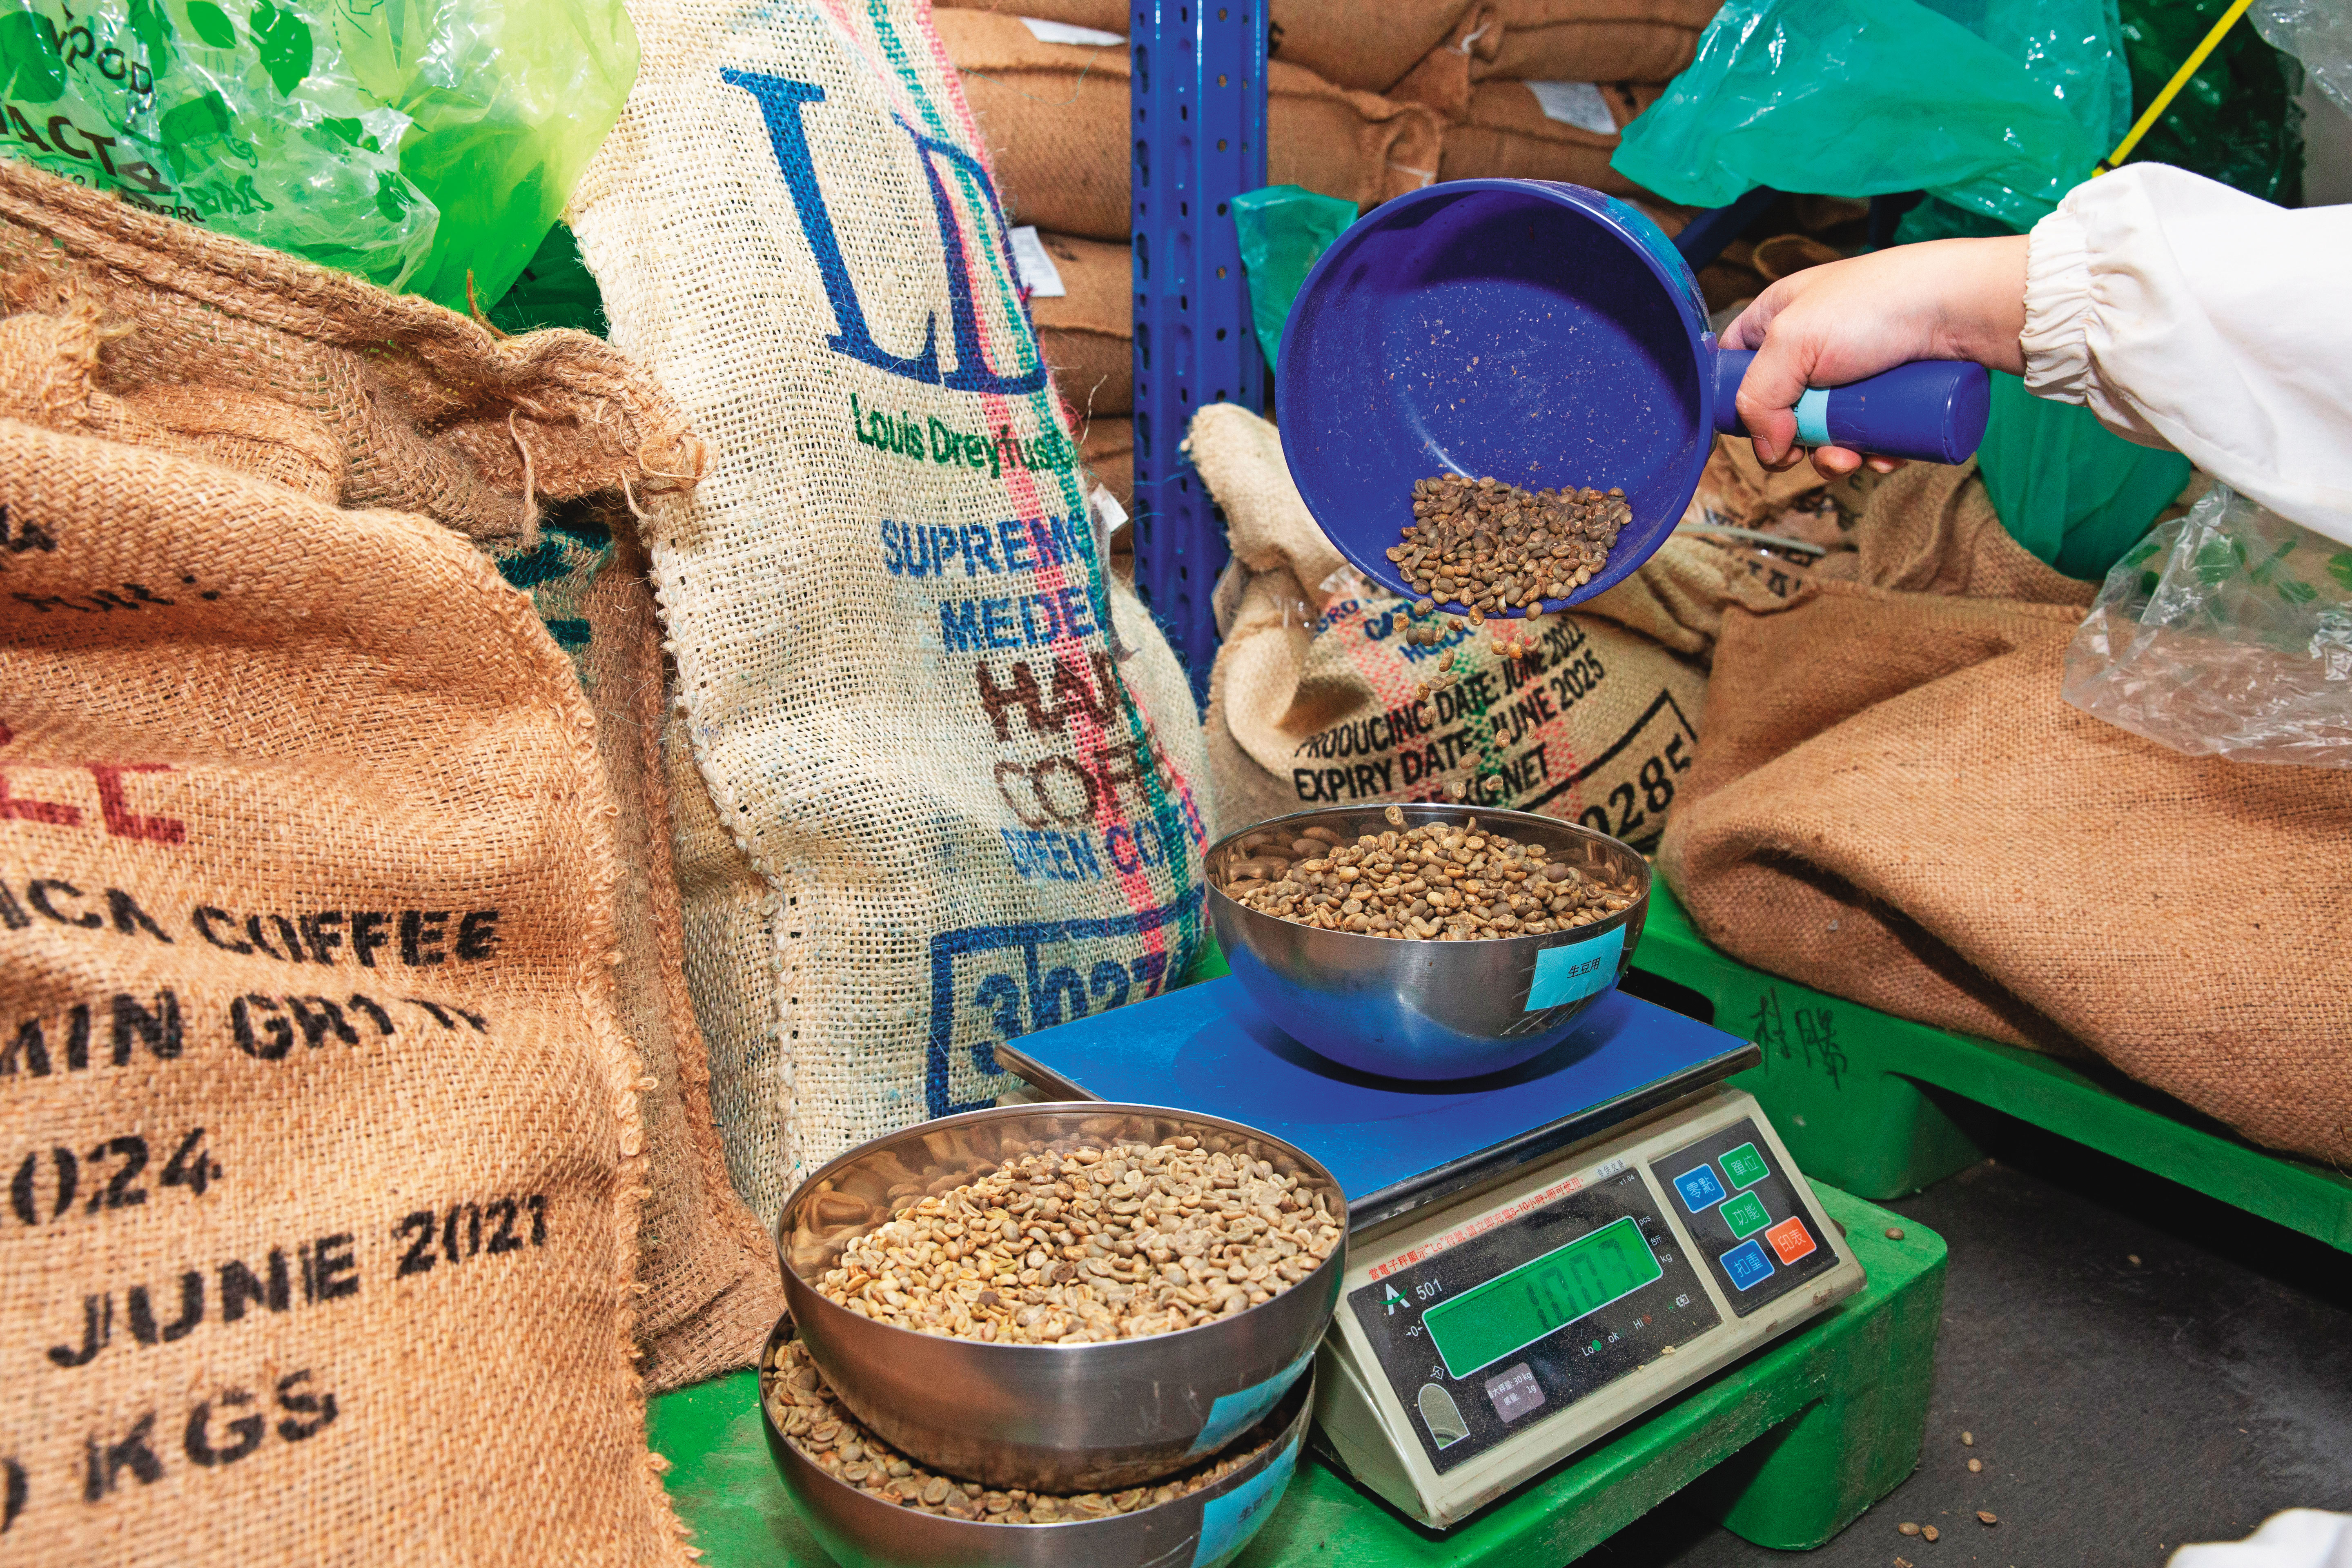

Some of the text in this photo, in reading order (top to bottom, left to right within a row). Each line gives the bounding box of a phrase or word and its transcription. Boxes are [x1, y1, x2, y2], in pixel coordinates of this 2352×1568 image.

[851, 392, 924, 461] Louis
[1293, 757, 1393, 802] EXPIRY
[1490, 685, 1557, 752] JUNE
[1552, 650, 1605, 711] 2025
[192, 906, 499, 968] COFFEE
[1566, 957, 1601, 979] 生豆用
[1597, 1159, 1625, 1178] 非供交易
[1731, 1155, 1759, 1176] 單位
[1639, 1215, 1651, 1227] pcs
[1733, 1203, 1760, 1226] 功能
[1777, 1229, 1806, 1253] 印表
[1660, 1253, 1673, 1263] kg
[1734, 1251, 1764, 1278] 扣重
[47, 1231, 359, 1368] JUNE
[1416, 1278, 1442, 1301] 501
[1633, 1318, 1644, 1330] Hi
[1608, 1332, 1620, 1343] ok
[1581, 1346, 1594, 1356] Lo
[1512, 1376, 1523, 1385] 30
[1521, 1371, 1533, 1381] kg
[83, 1368, 340, 1503] KGS
